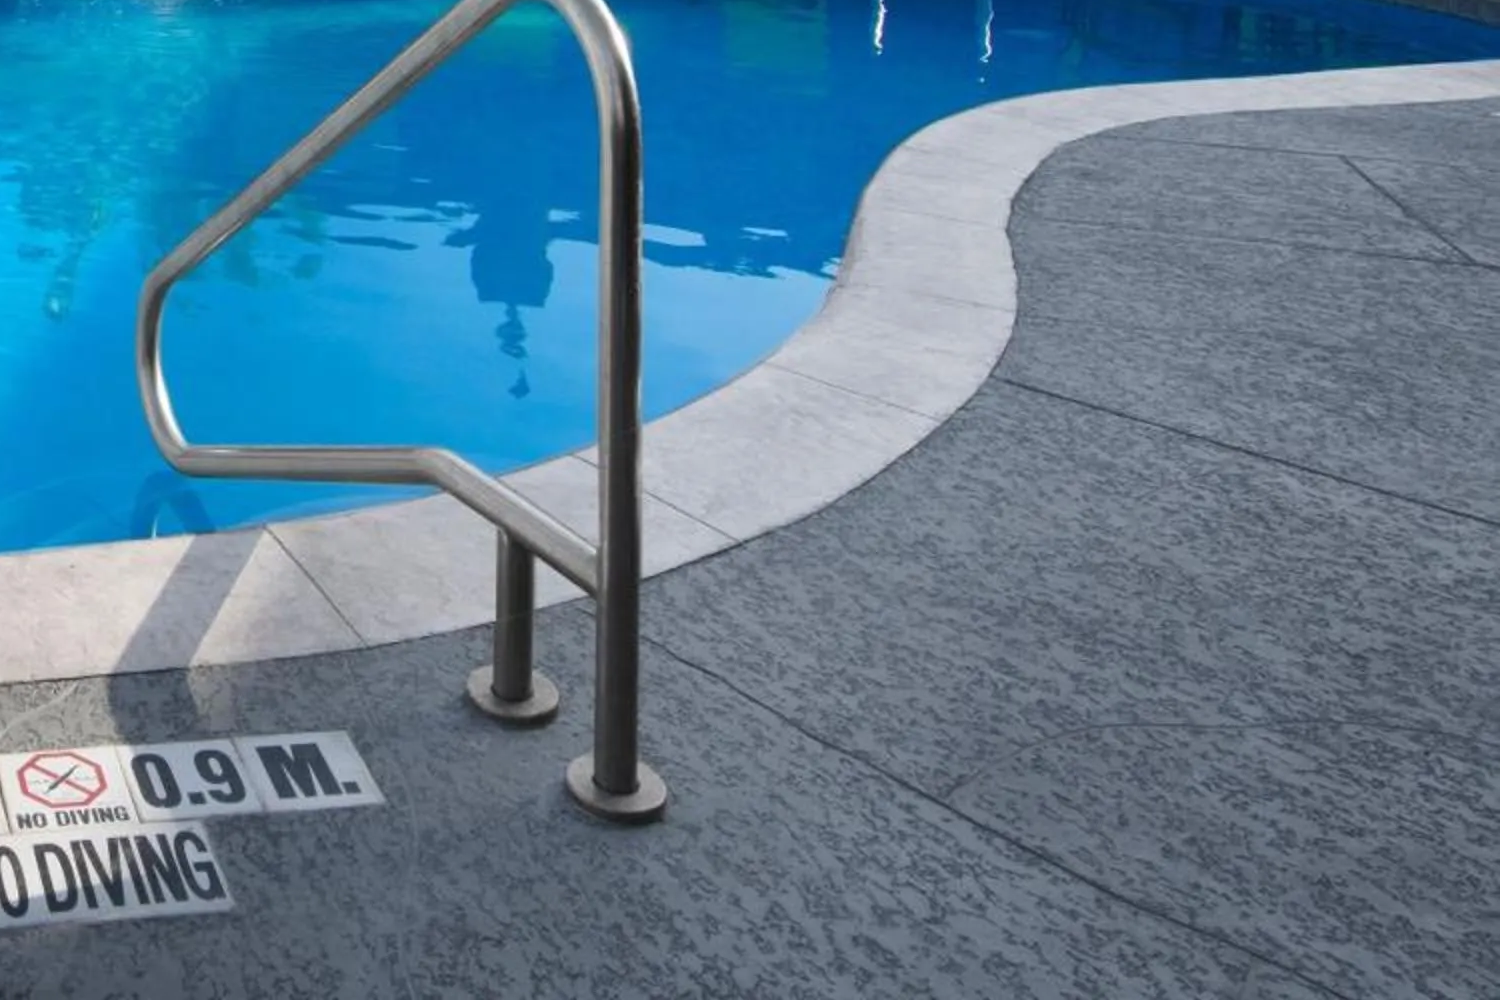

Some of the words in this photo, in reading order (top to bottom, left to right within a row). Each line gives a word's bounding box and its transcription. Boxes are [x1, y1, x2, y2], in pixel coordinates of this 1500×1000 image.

[131, 749, 247, 809] 0.9
[255, 742, 362, 800] M.
[15, 810, 49, 830] NO
[54, 804, 131, 827] DIVING
[32, 830, 227, 914] DIVING
